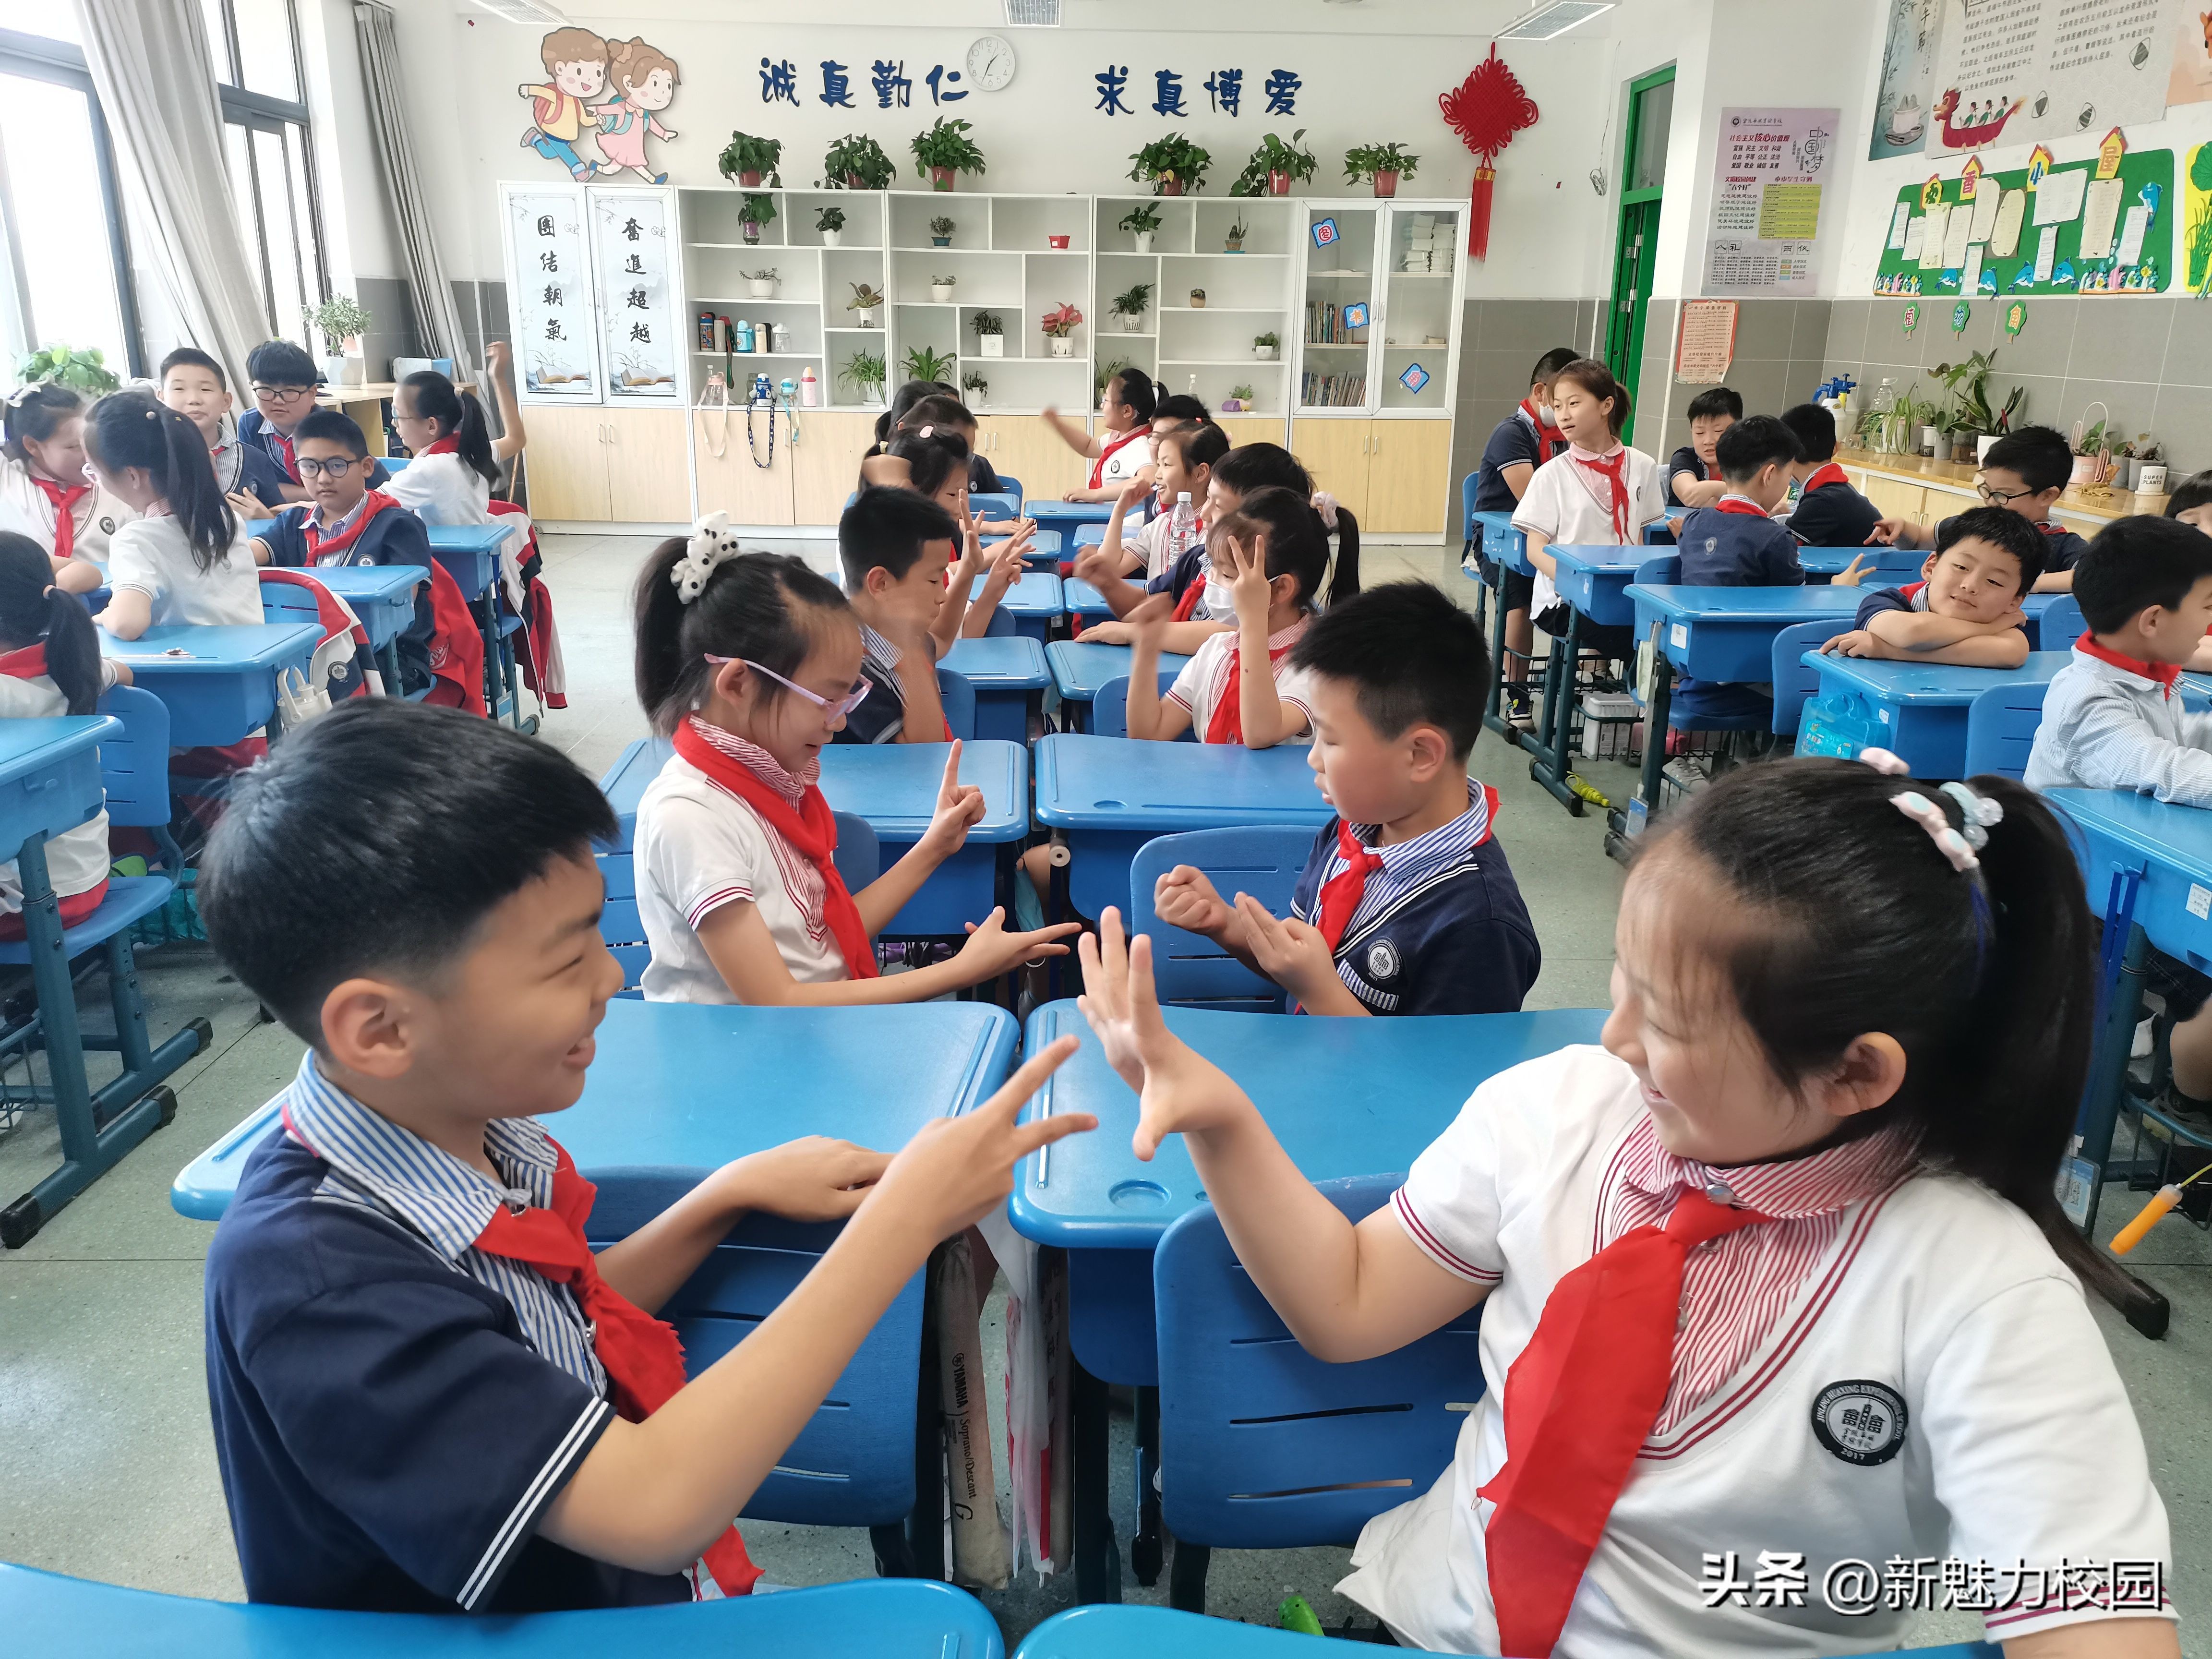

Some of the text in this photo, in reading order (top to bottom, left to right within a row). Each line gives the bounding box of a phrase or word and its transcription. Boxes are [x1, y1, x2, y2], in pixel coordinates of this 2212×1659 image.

[1095, 65, 1302, 116] 求真博爱
[1730, 133, 1790, 142] 社会主义核心价值观
[953, 1364, 977, 1499] YAMAHA Soprano/Descant
[1840, 1448, 1865, 1460] 2017
